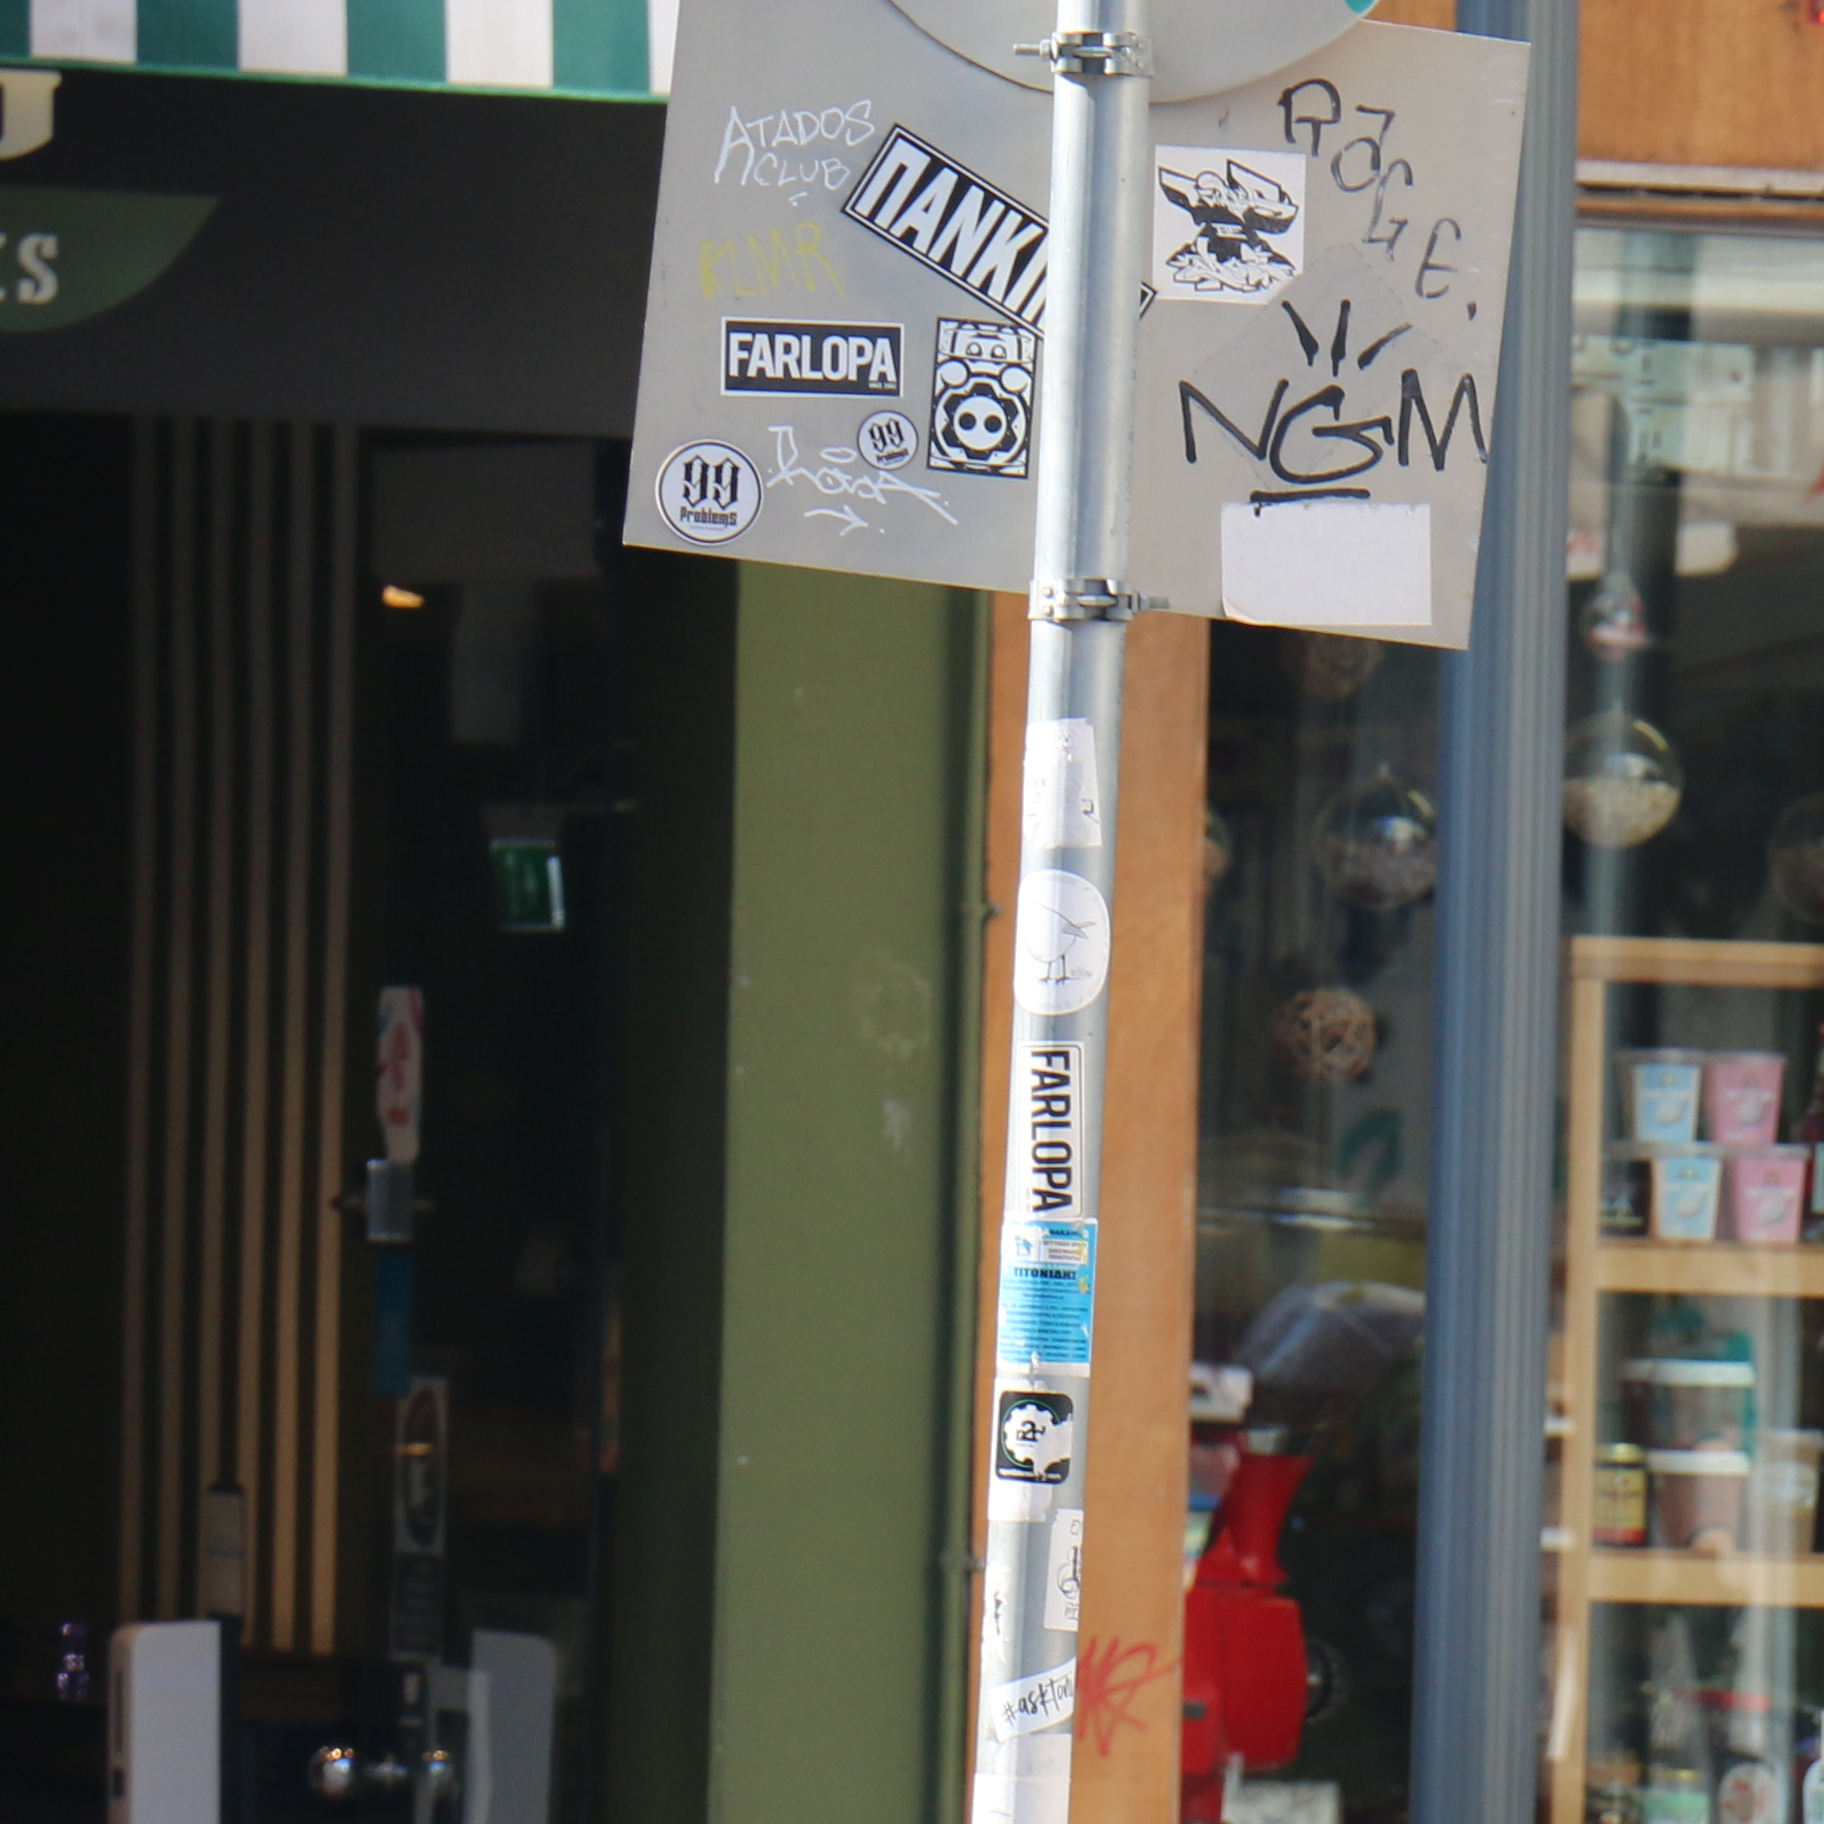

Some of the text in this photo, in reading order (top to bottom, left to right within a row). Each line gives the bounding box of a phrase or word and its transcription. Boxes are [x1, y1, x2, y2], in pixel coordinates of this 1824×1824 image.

[728, 331, 898, 382] FARLOPA
[682, 454, 741, 510] 99
[679, 506, 738, 528] Problems
[1030, 1049, 1074, 1213] FARLOPA
